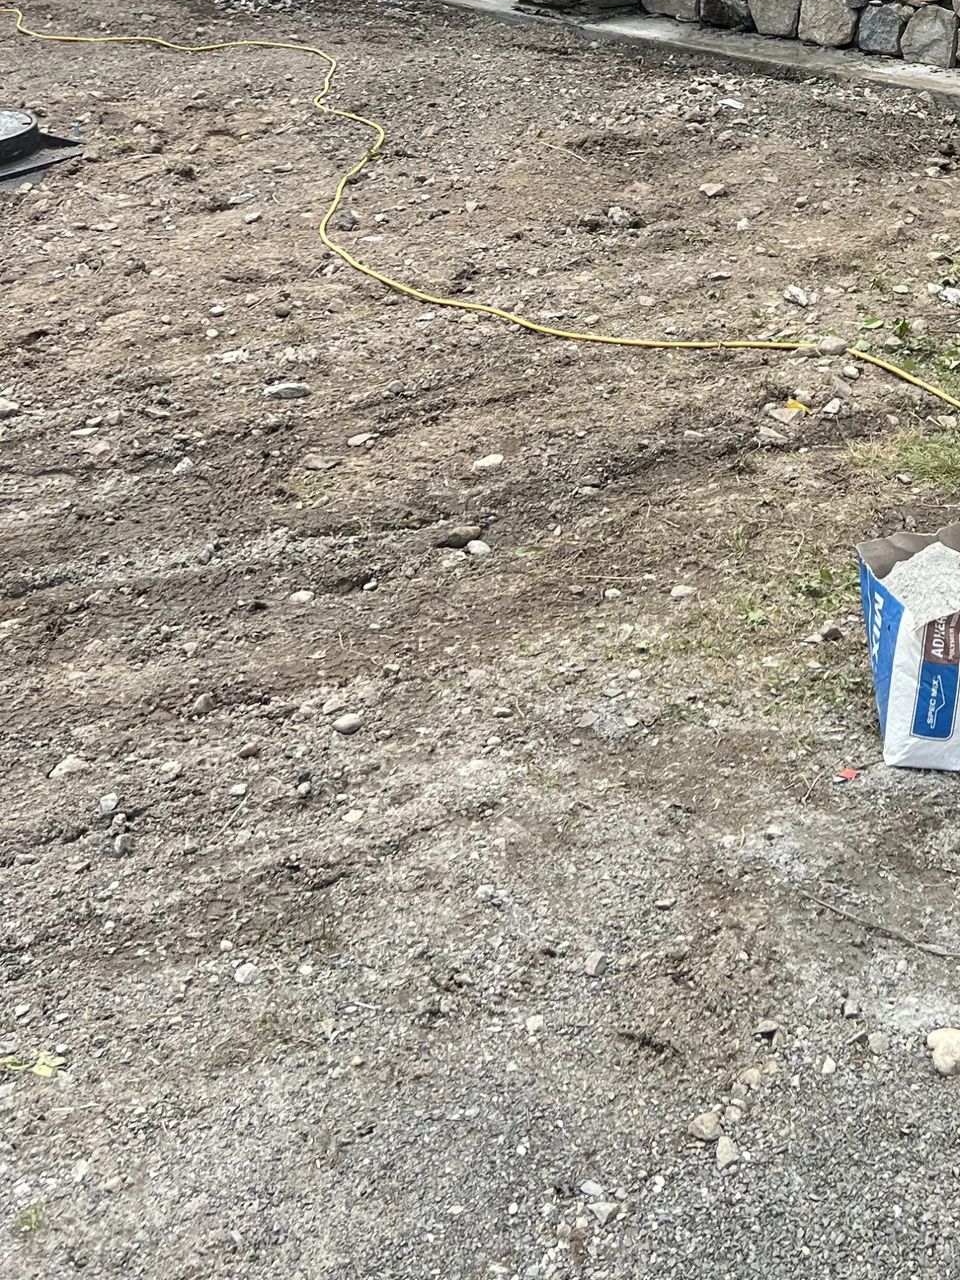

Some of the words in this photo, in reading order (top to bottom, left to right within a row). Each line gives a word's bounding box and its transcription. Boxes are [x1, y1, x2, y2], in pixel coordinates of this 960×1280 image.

[872, 591, 885, 664] MIX
[931, 678, 939, 697] MIX
[927, 697, 937, 725] SPEC
